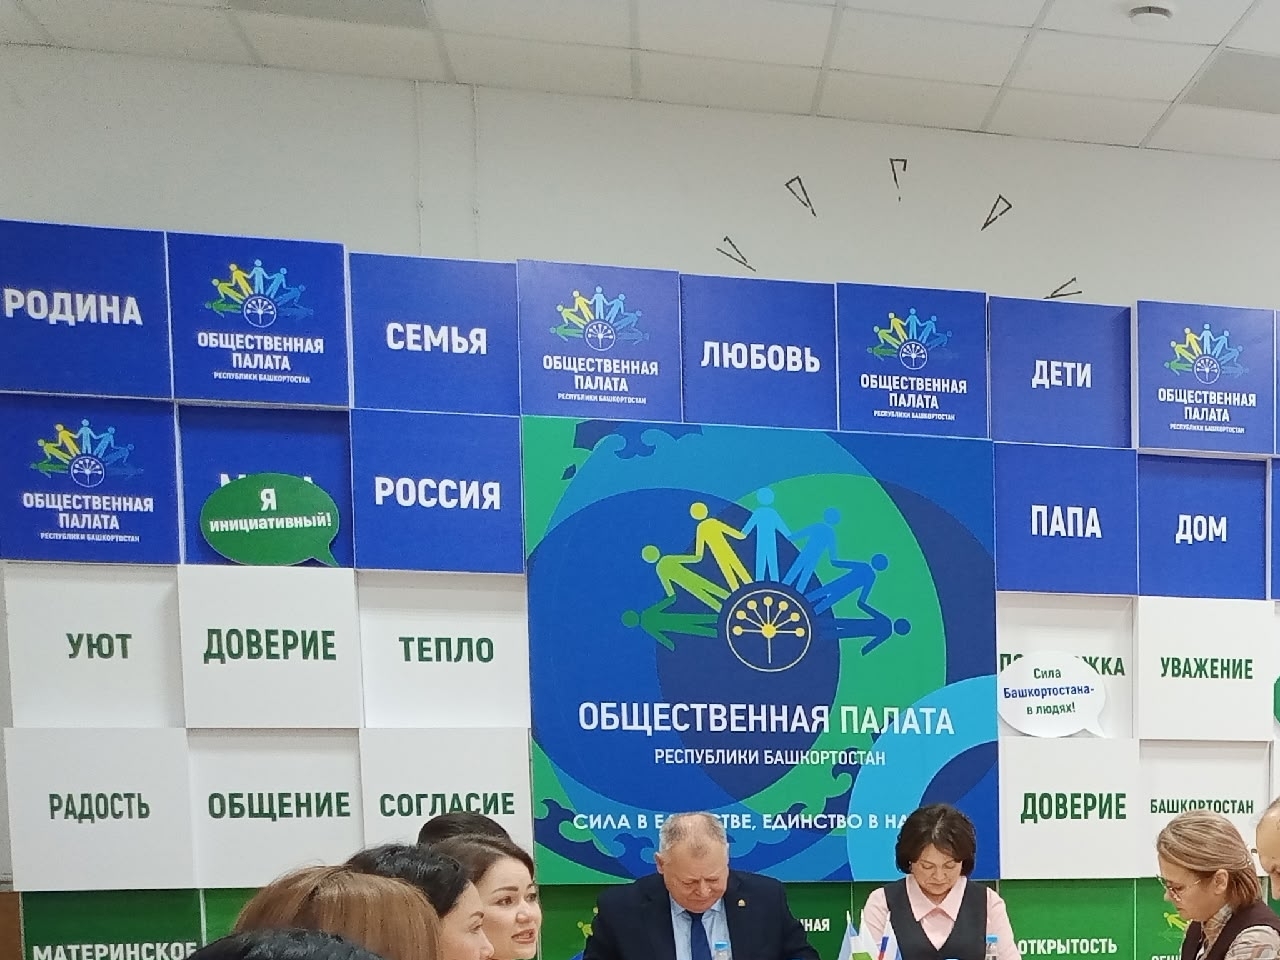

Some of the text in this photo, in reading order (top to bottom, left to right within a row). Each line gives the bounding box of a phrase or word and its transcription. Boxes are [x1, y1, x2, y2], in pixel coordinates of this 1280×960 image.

[3, 287, 142, 327] РОДИНА
[197, 332, 324, 354] ОБЩЕСТВЕННАЯ
[386, 321, 488, 356] СЕМЬЯ
[232, 352, 291, 371] ПАЛАТА
[543, 355, 659, 376] ОБЩЕСТВЕННАЯ
[700, 340, 821, 374] ЛЮБОВЬ
[574, 375, 629, 392] ПАЛАТА
[860, 373, 967, 394] ОБЩЕСТВЕННАЯ
[1031, 359, 1093, 389] ДЕТИ
[889, 393, 939, 409] ПАЛАТА
[1158, 388, 1257, 407] ОБЩЕСТВЕННАЯ
[1184, 406, 1230, 422] ПАЛАТА
[22, 492, 154, 513] ОБЩЕСТВЕННАЯ
[260, 488, 277, 512] Я
[374, 476, 502, 511] РОССИЯ
[58, 512, 120, 530] ПАЛАТА
[209, 512, 332, 533] инициативный!
[1030, 505, 1103, 539] ПАПА
[1175, 514, 1228, 545] ДОМ
[66, 632, 132, 660] УЮТ
[203, 627, 338, 665] ДОВЕРИЕ
[399, 636, 495, 663] ТЕПЛО
[1033, 668, 1062, 679] Сила
[1160, 656, 1254, 681] УВАЖЕНИЕ
[577, 701, 955, 737] ОБЩЕСТВЕННАЯ ПАЛАТА
[1026, 701, 1076, 715] в людях!
[654, 748, 887, 767] РЕСПУБЛИКИ БАШКОРТОСТАН
[49, 792, 151, 824] РАДОСТЬ
[207, 791, 352, 821] ОБЩЕНИЕ
[379, 792, 516, 817] СОГЛАСИЕ
[1020, 792, 1128, 825] ДОВЕРИЕ
[1149, 799, 1255, 814] БАШКОРТОСТАН
[572, 813, 633, 830] СИЛА
[638, 814, 649, 830] В
[762, 813, 863, 831] ЕДИНСТВО
[868, 815, 879, 830] В
[1018, 936, 1118, 956] ОТКРЫТОСТЬ
